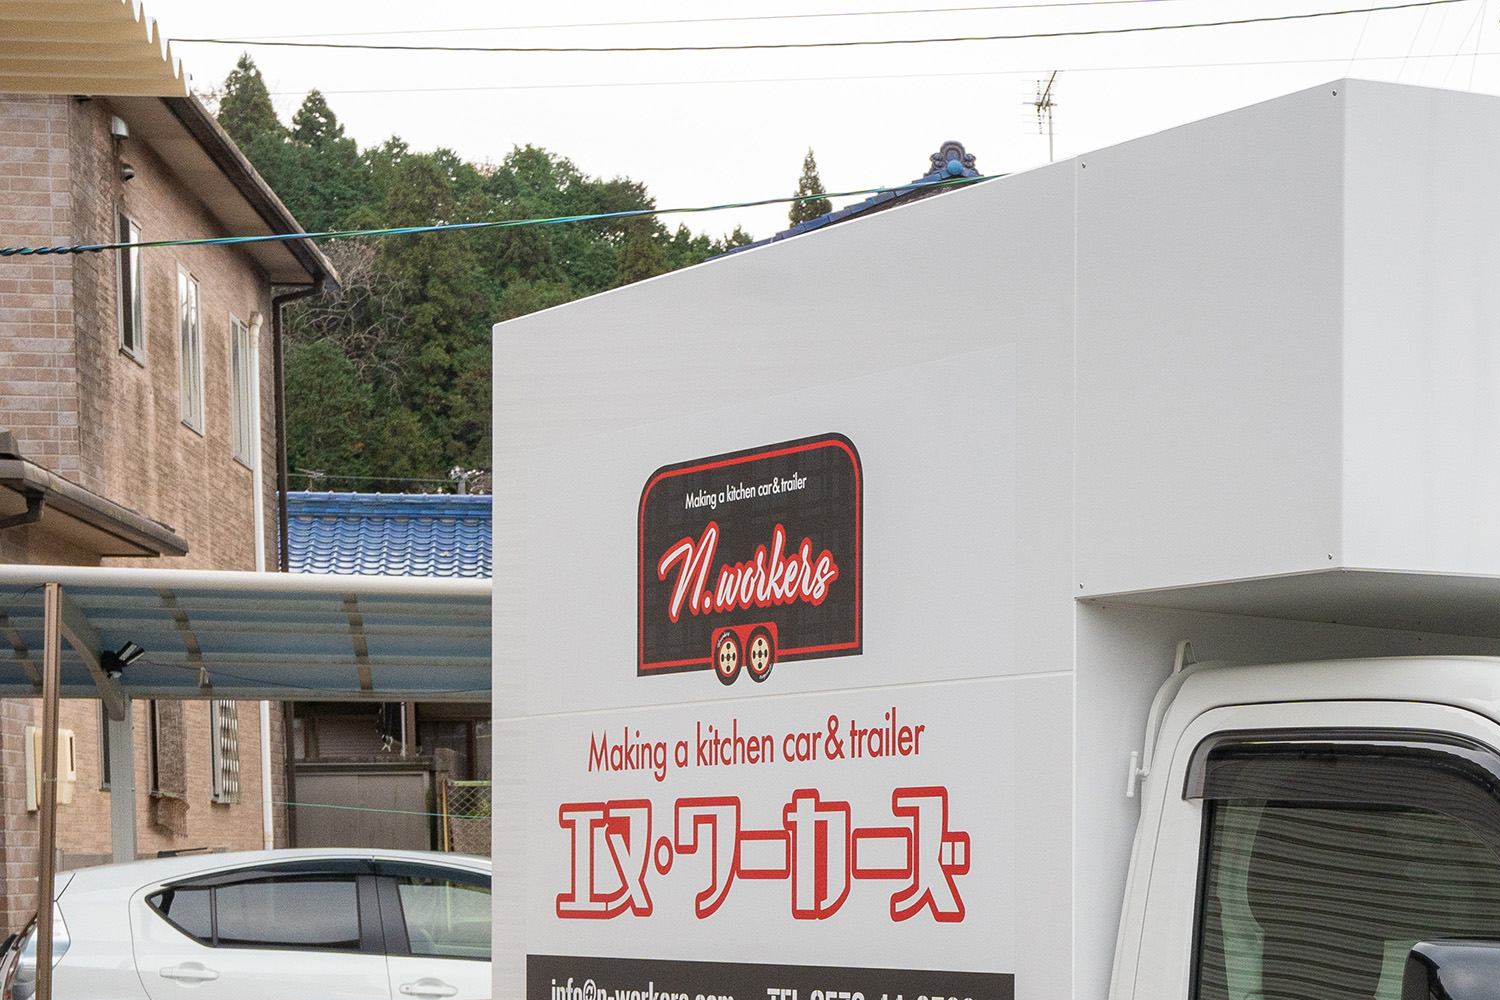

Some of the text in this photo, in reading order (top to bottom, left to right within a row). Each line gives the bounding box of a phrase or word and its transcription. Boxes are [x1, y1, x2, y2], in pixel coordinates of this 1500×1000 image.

[685, 489, 717, 510] Making
[718, 492, 725, 503] a
[726, 482, 756, 502] kitchen
[588, 726, 667, 782] Making
[674, 740, 688, 768] a
[697, 718, 774, 767] kitchen
